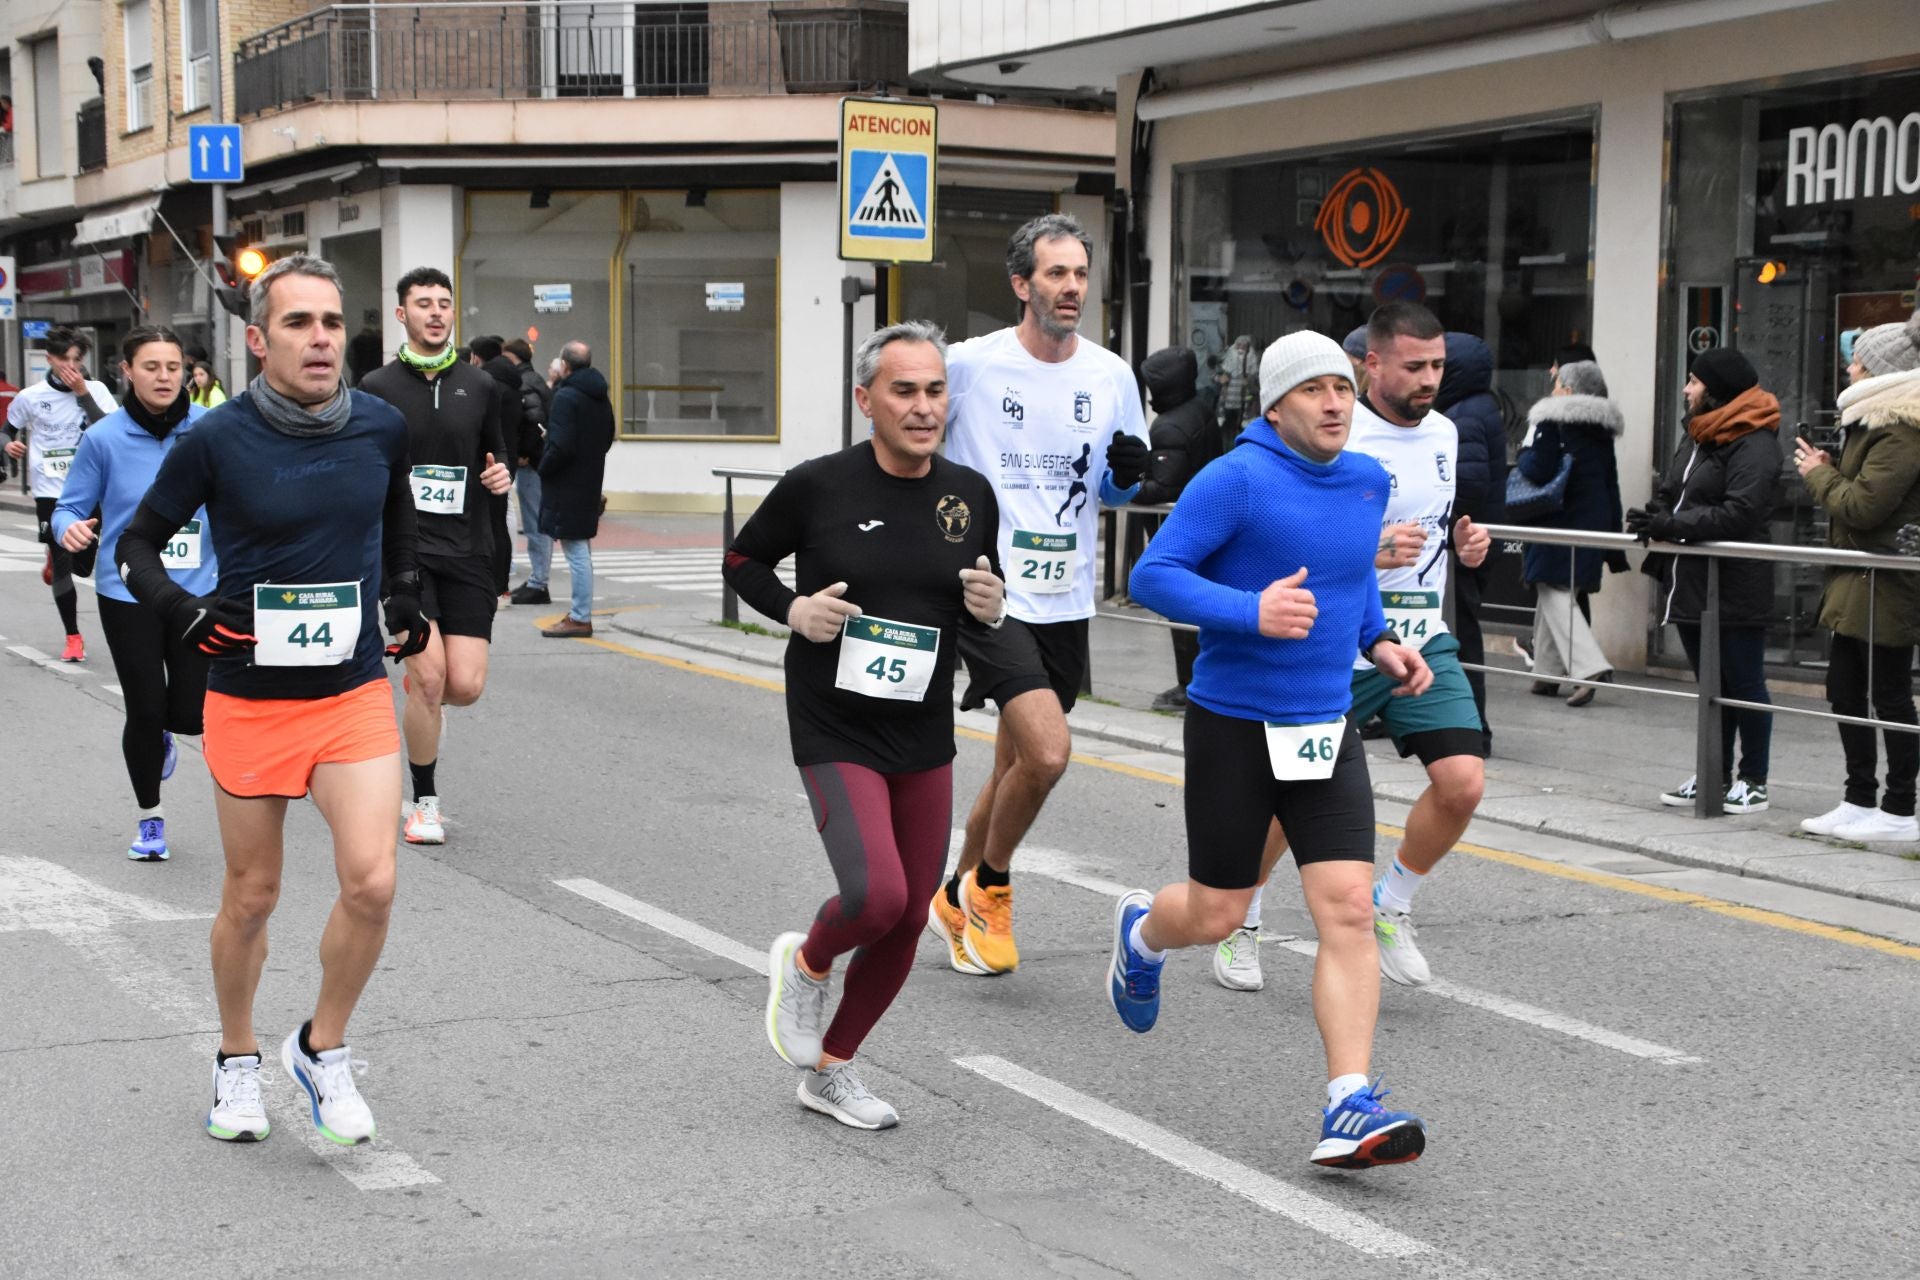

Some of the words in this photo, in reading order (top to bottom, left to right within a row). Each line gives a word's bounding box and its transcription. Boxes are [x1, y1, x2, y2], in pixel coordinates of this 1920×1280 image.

[848, 114, 931, 136] ATENCION
[1786, 112, 1920, 207] RAMO
[1001, 453, 1022, 468] SAN
[1025, 454, 1071, 470] SILVESTRE
[420, 486, 455, 503] 244
[1021, 560, 1066, 580] 215
[288, 622, 333, 648] 44
[866, 656, 907, 683] 45
[1298, 737, 1334, 762] 46
